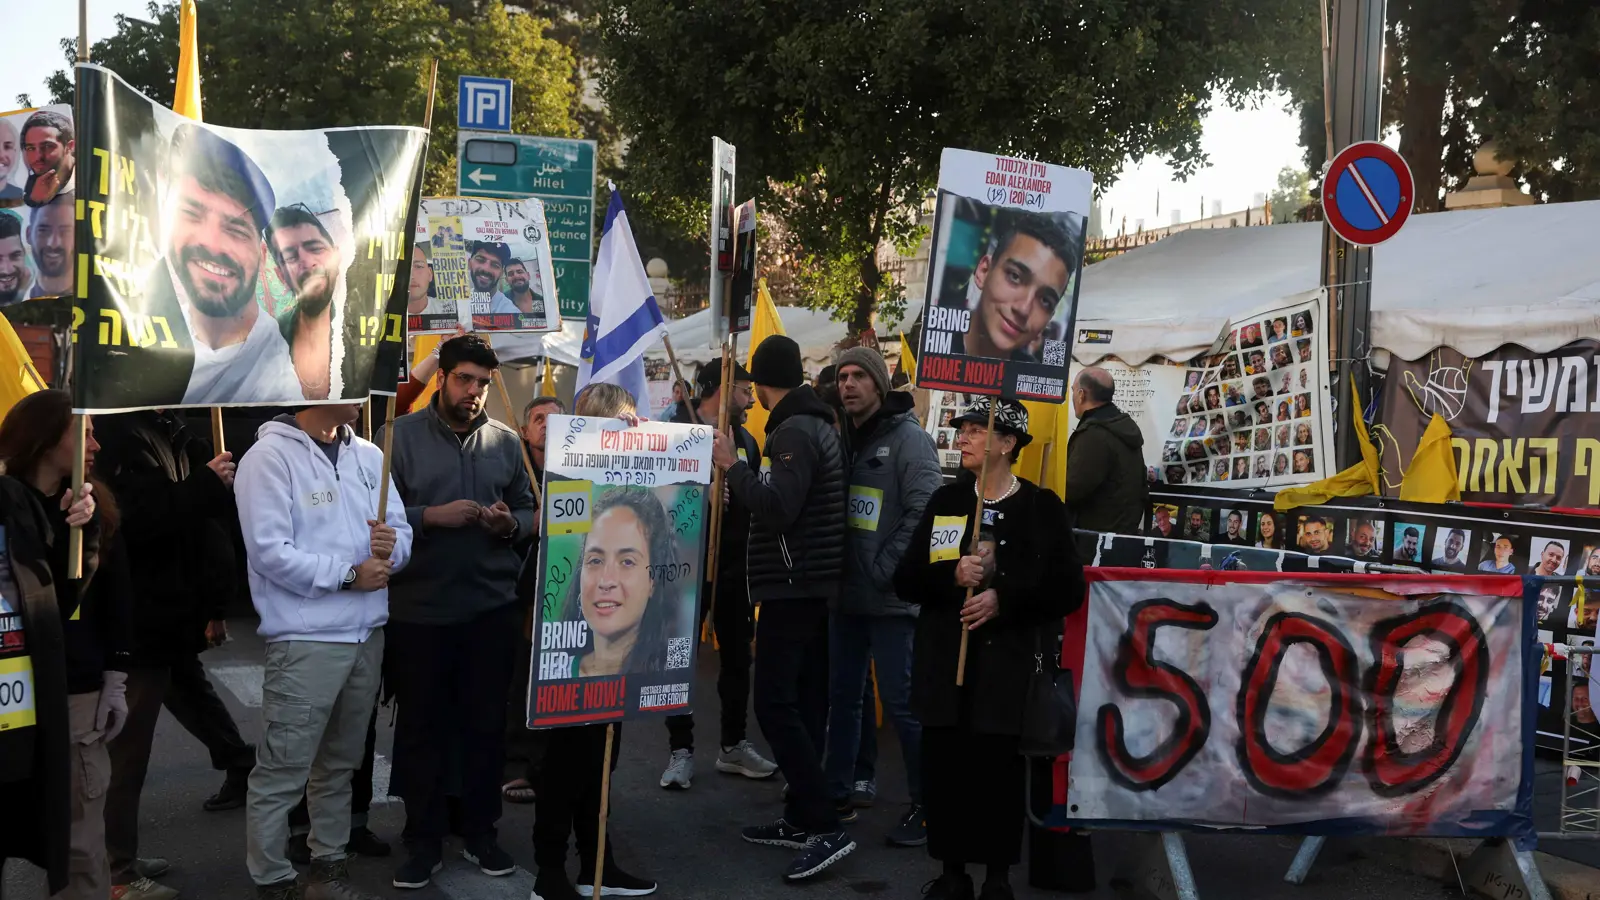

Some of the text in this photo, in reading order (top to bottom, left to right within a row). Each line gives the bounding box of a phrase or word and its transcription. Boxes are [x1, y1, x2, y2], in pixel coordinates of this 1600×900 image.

[996, 157, 1046, 178] עידן אלכסנדר
[533, 177, 565, 189] Hilel
[985, 171, 1052, 194] EDAN ALEXANDER
[1009, 189, 1026, 206] (20)
[579, 204, 588, 217] גן
[502, 228, 518, 236] BERMAN
[432, 257, 467, 271] BRING
[435, 271, 467, 285] THEM
[437, 285, 470, 300] HOME
[470, 292, 491, 302] BRING
[470, 303, 491, 313] THEM
[493, 314, 515, 327] NOW!
[927, 306, 971, 333] BRING
[924, 330, 953, 355] HIM
[922, 356, 1005, 387] HOME NOW!
[1017, 374, 1064, 387] HOSTAGES AND MISSING
[1016, 381, 1063, 397] FAMILIES FORUM
[562, 417, 587, 451] סליחה
[600, 429, 668, 452] ענבר הימן (27)
[675, 427, 707, 454] סליחה
[561, 452, 699, 473] נרצחה על ידי חמאס. עדיין חטופה בעזה.
[312, 491, 333, 506] 500
[553, 497, 585, 518] 500
[668, 488, 700, 522] סליחה
[850, 498, 875, 516] 500
[676, 509, 700, 536] ענבר
[931, 529, 959, 547] 500
[541, 556, 573, 621] נשכחה
[540, 620, 588, 650] BRING
[538, 652, 570, 681] HER
[536, 675, 627, 714] HOME NOW!
[641, 682, 690, 696] HOSTAGES AND MISSING
[1097, 594, 1490, 798] 500
[640, 691, 689, 708] FAMILIES FORUM
